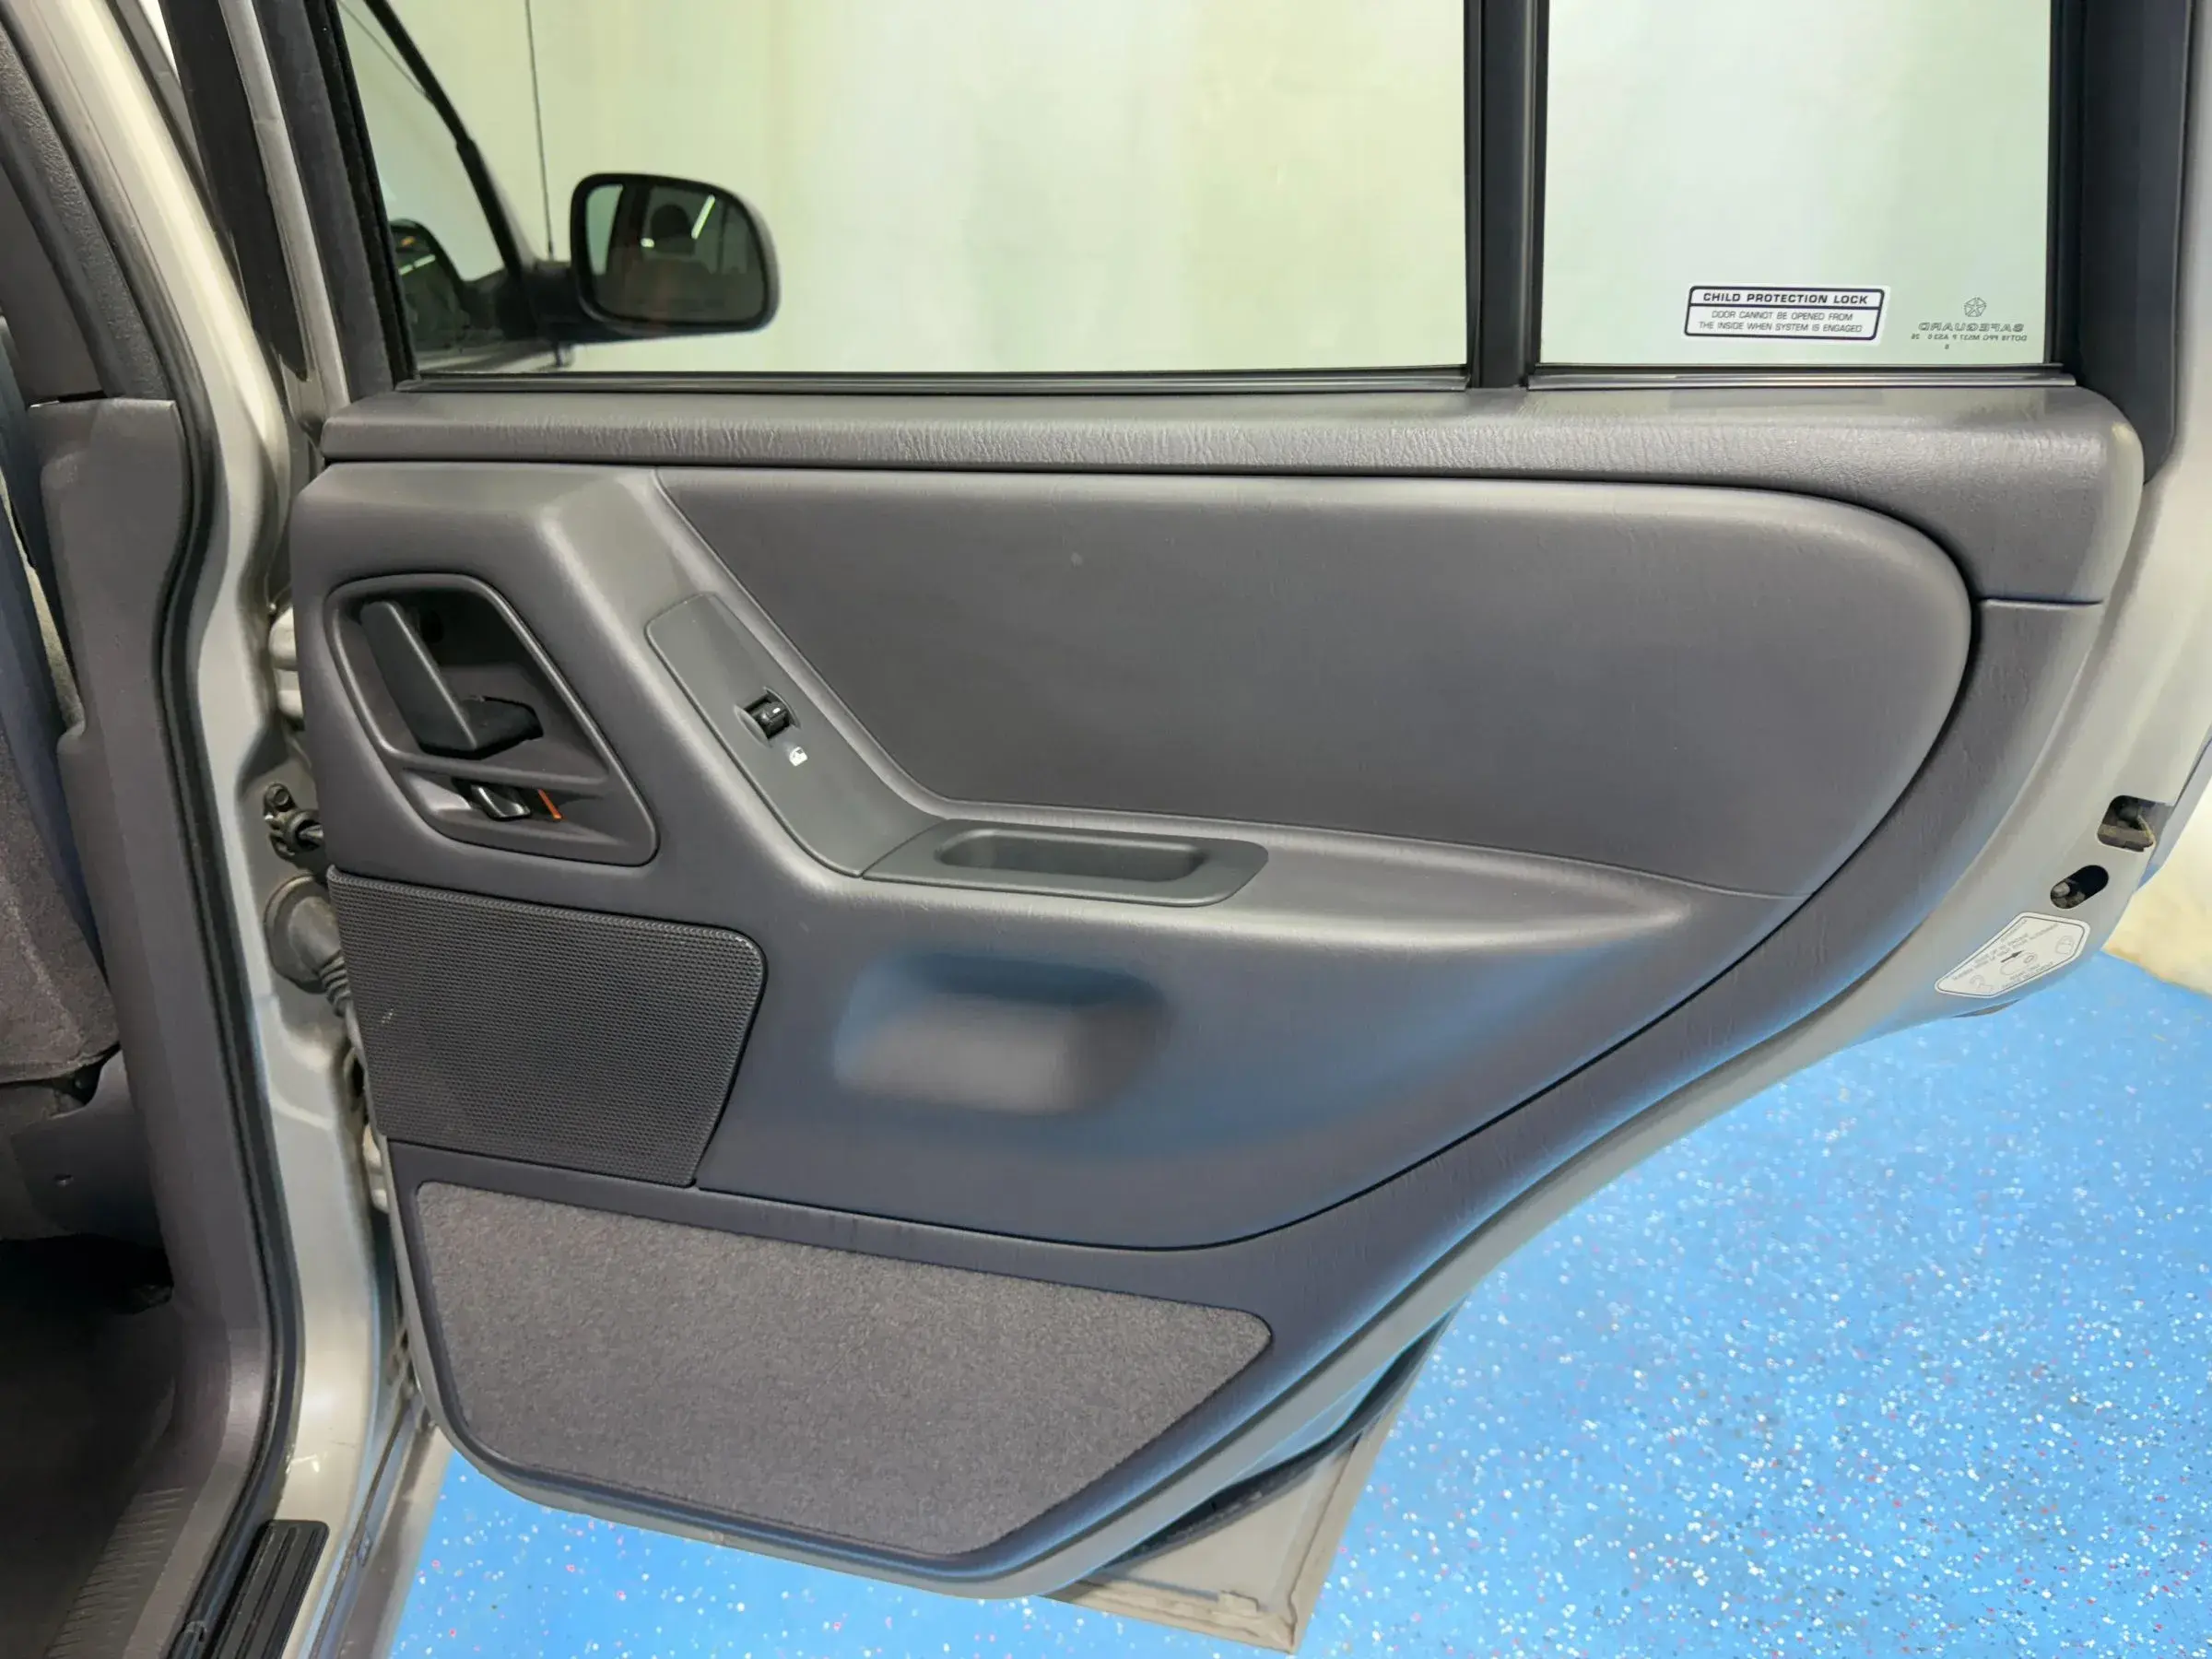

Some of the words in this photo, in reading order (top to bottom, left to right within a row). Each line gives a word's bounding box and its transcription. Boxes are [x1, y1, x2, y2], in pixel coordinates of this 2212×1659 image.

[1703, 293, 1741, 301] CHILD
[1747, 293, 1828, 303] PROTECTION
[1833, 295, 1868, 304] LOCK
[1712, 310, 1736, 319] DOOR
[1739, 311, 1773, 319] CANNOT
[1777, 312, 1787, 320] BE
[1828, 312, 1853, 321] FROM
[1718, 322, 1744, 330] INSIDE
[1747, 323, 1772, 331] WHEN
[1775, 324, 1808, 332] SYSTEM
[1823, 324, 1863, 333] ENGAGED
